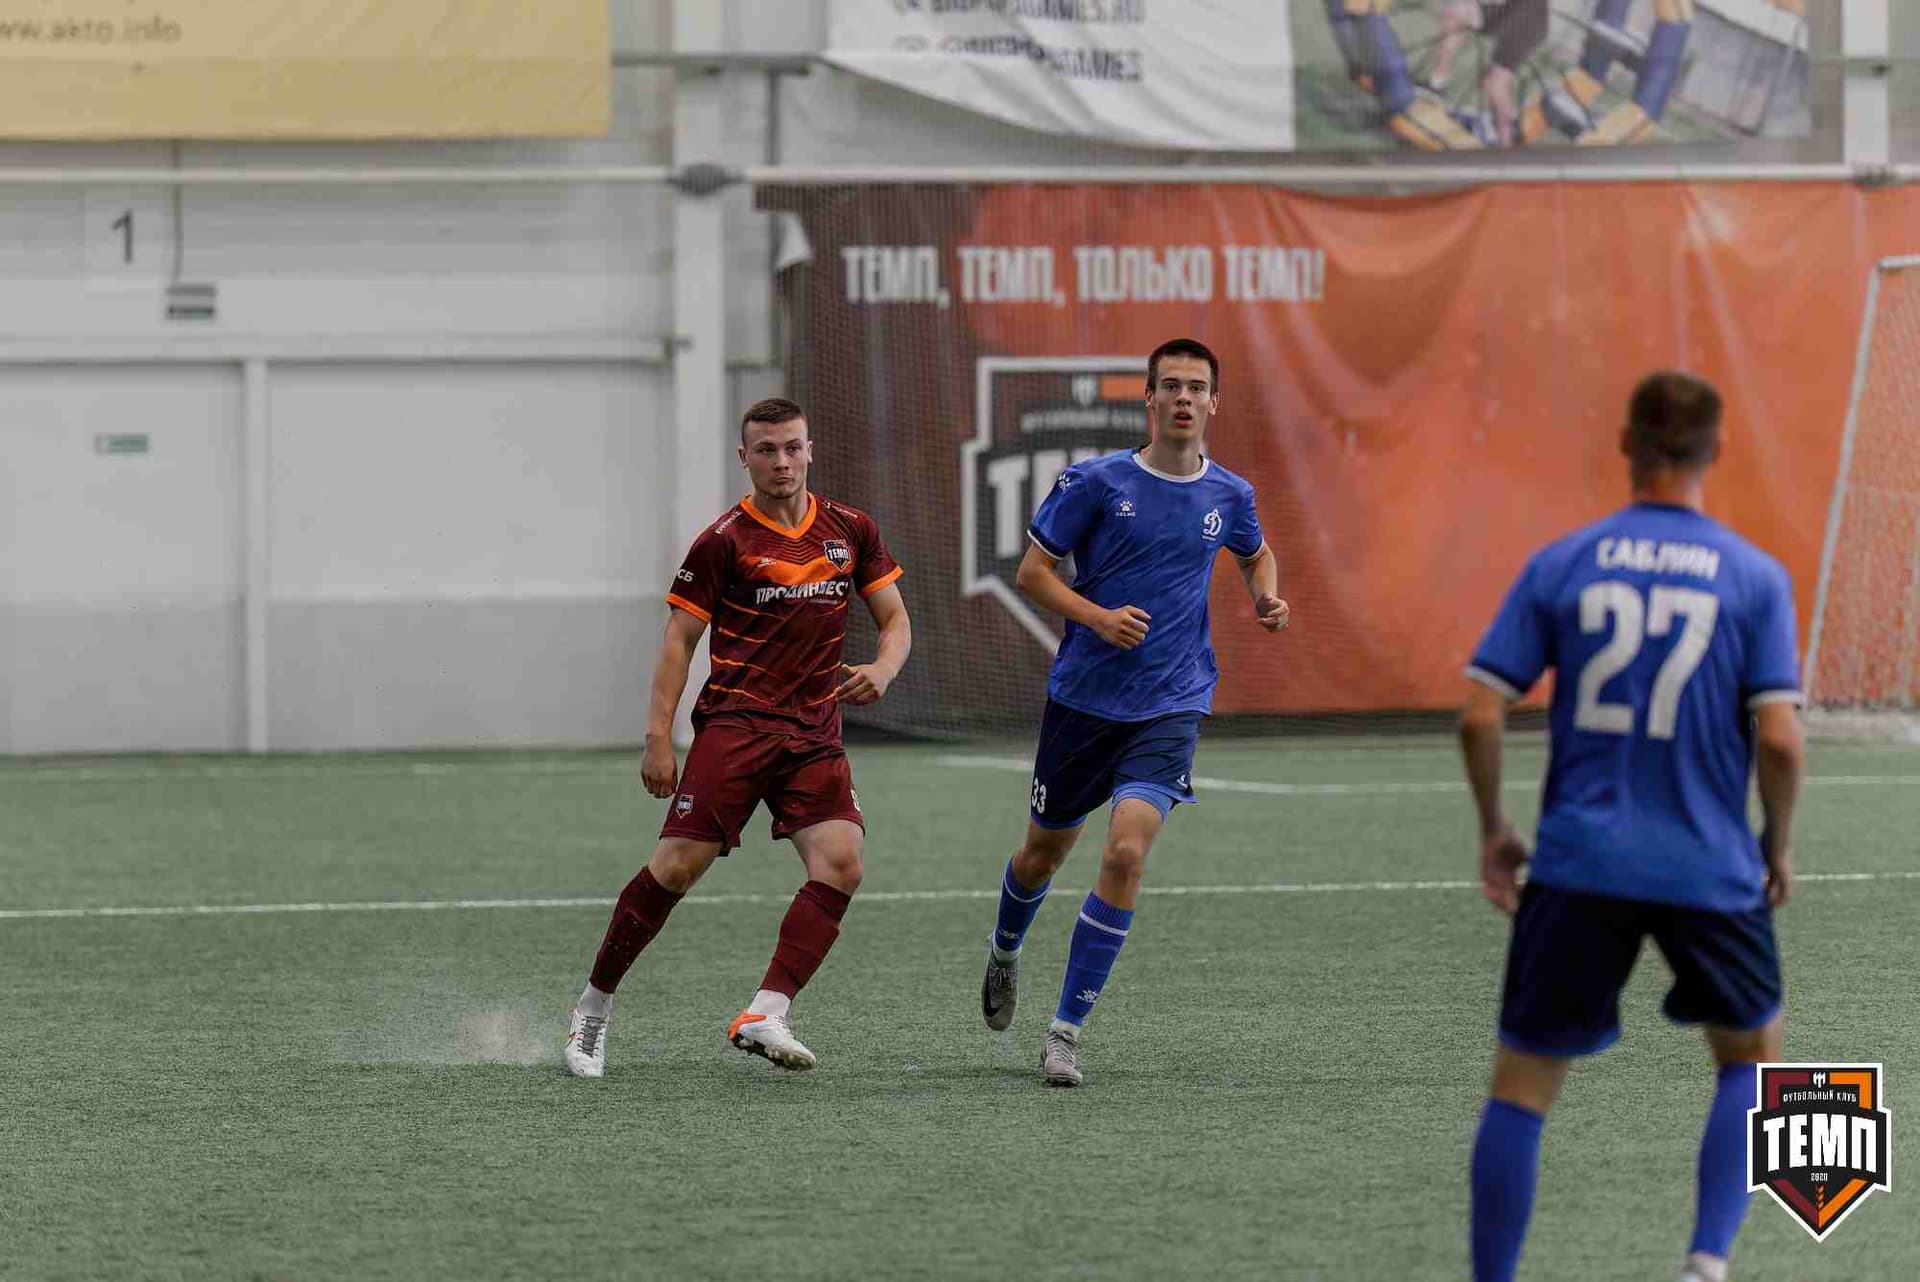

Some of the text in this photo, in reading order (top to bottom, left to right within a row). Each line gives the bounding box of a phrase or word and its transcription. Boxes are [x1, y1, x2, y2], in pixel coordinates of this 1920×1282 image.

[111, 209, 134, 264] 1
[841, 245, 1326, 307] ТЕМП, ТЕМП, ТОЛЬКО ТЕМП!
[1596, 537, 1719, 580] САБЛИН
[755, 581, 849, 605] ПРОДИНВЕС
[1574, 581, 1718, 738] 27
[1031, 777, 1047, 814] 33
